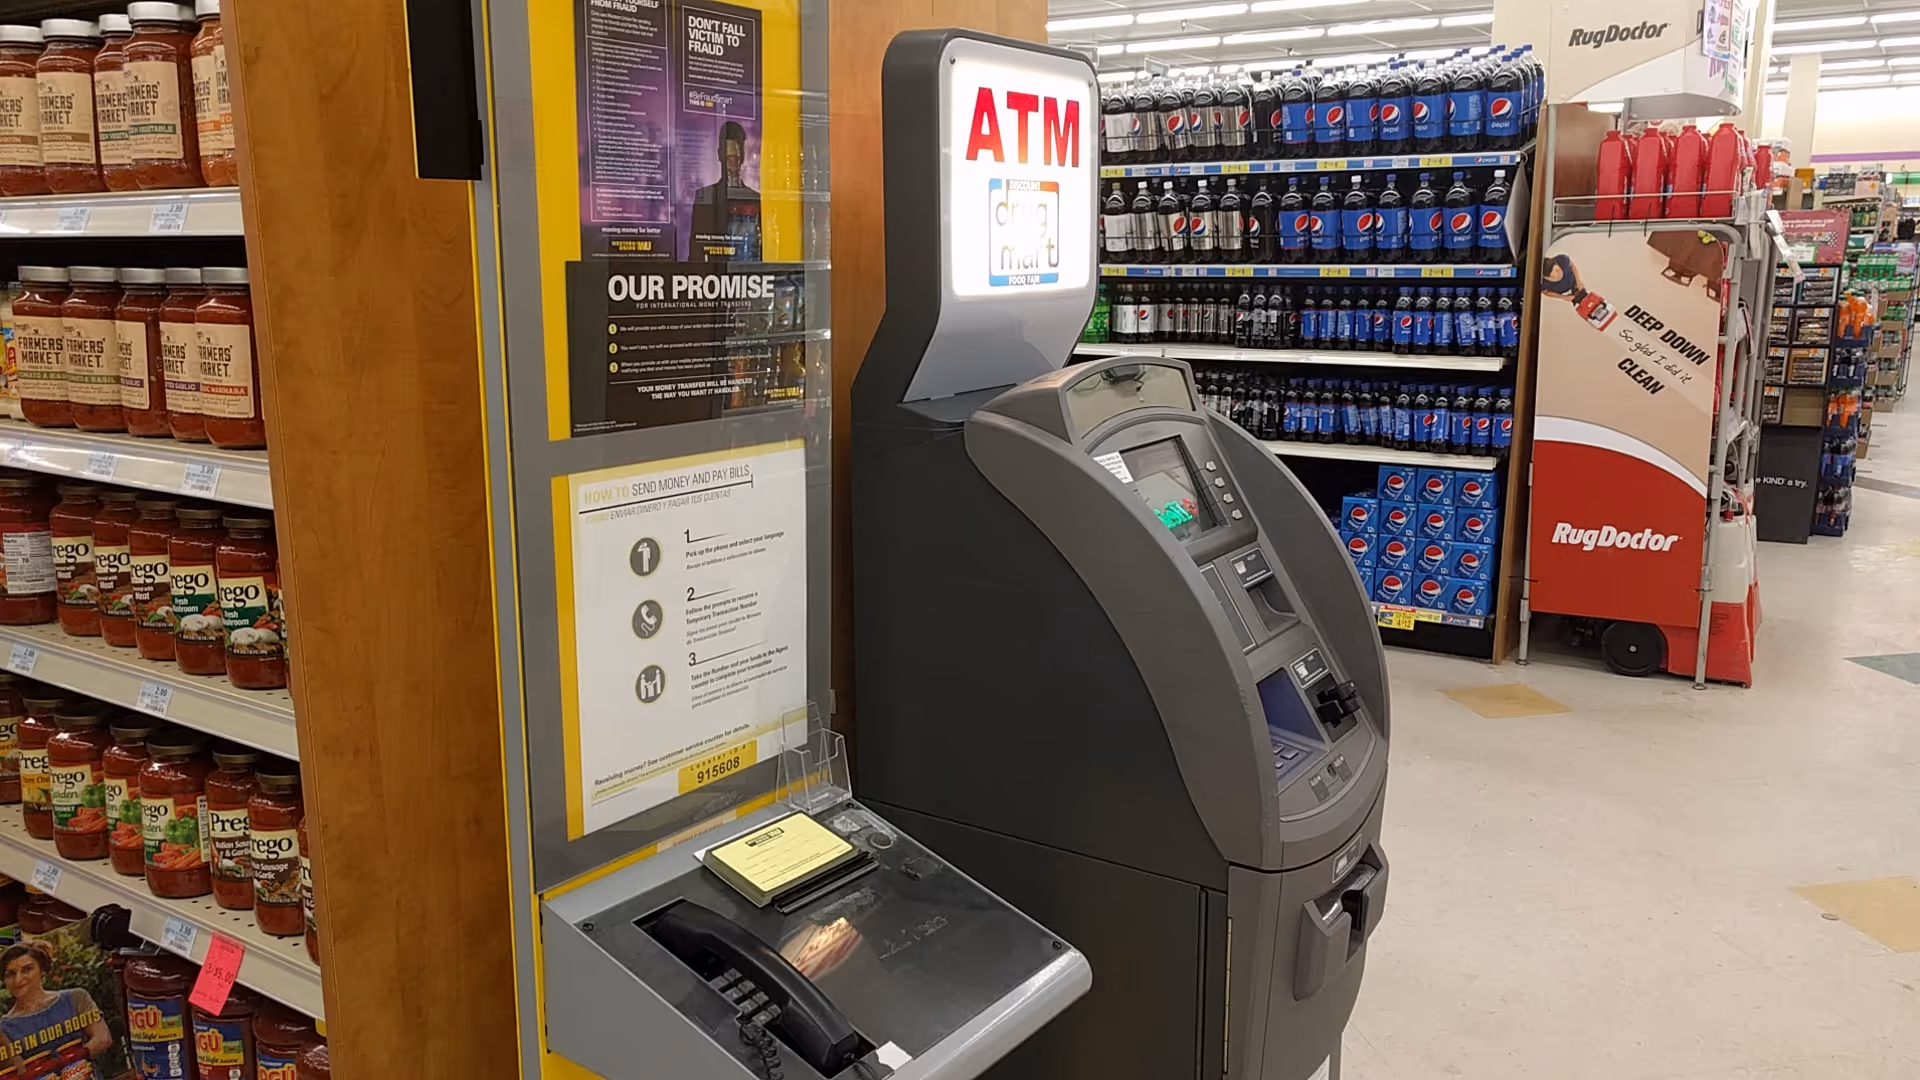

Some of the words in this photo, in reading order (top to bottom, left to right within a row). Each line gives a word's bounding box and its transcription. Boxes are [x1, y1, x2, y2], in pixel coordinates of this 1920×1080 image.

[591, 0, 612, 8] FROM
[613, 2, 637, 12] FRAUD
[688, 16, 720, 31] DON'T
[722, 22, 746, 37] FALL
[1568, 21, 1668, 48] RugDoctor
[688, 28, 724, 44] VICTIM
[726, 34, 740, 47] TO
[688, 40, 724, 56] FRAUD
[966, 86, 1079, 168] ATM
[1383, 126, 1399, 134] pepsi
[608, 275, 664, 300] OUR
[672, 274, 775, 300] PROMISE
[1009, 276, 1026, 285] FOOD
[1624, 305, 1664, 332] DEEP
[1660, 329, 1710, 366] DOWN
[1619, 329, 1633, 342] So
[1629, 340, 1654, 358] glad
[1654, 356, 1667, 366] I
[1664, 364, 1678, 376] did
[1679, 372, 1694, 384] it
[637, 385, 654, 393] YOUR
[677, 381, 706, 390] TRANSFER
[1618, 358, 1664, 395] CLEAN
[691, 389, 706, 397] WANT
[584, 488, 612, 504] HOW
[616, 486, 629, 498] TO
[632, 481, 656, 496] SEND
[658, 475, 690, 492] MONEY
[692, 470, 710, 485] AND
[712, 468, 728, 482] PAY
[730, 464, 749, 478] BILLS
[1763, 476, 1784, 485] KIND
[610, 506, 636, 520] ENVIAR
[636, 502, 662, 515] DINERO
[668, 496, 690, 510] PAGAR
[691, 494, 702, 504] TUS
[704, 488, 732, 502] CUENTAS
[684, 529, 690, 543] 1
[1552, 522, 1678, 551] RugDoctor
[53, 543, 89, 564] rego
[686, 550, 697, 558] Pick
[714, 544, 728, 553] phone
[96, 552, 130, 574] rego
[131, 562, 168, 584] rego
[171, 572, 209, 596] rego
[686, 587, 695, 602] 2
[135, 592, 150, 600] Meat
[220, 584, 260, 608] rego
[686, 607, 702, 615] Follow
[712, 599, 730, 609] prompts
[686, 614, 711, 625] Temporary
[712, 606, 738, 618] Transaction
[740, 601, 758, 609] Number
[689, 652, 696, 666] 3
[712, 664, 729, 674] Number
[18, 752, 48, 774] Preg
[595, 770, 623, 786] Receiving
[624, 762, 646, 775] money?
[648, 758, 658, 766] See
[659, 748, 684, 762] customer
[685, 740, 703, 751] service
[704, 733, 724, 744] counter
[724, 729, 732, 737] for
[697, 756, 740, 784] 915608
[142, 805, 168, 822] ego
[252, 838, 292, 860] rego
[260, 863, 288, 872] Sausage
[10, 1041, 22, 1056] IS
[24, 1034, 38, 1050] IN
[40, 1024, 64, 1044] OUR
[64, 1008, 100, 1034] ROOTS
